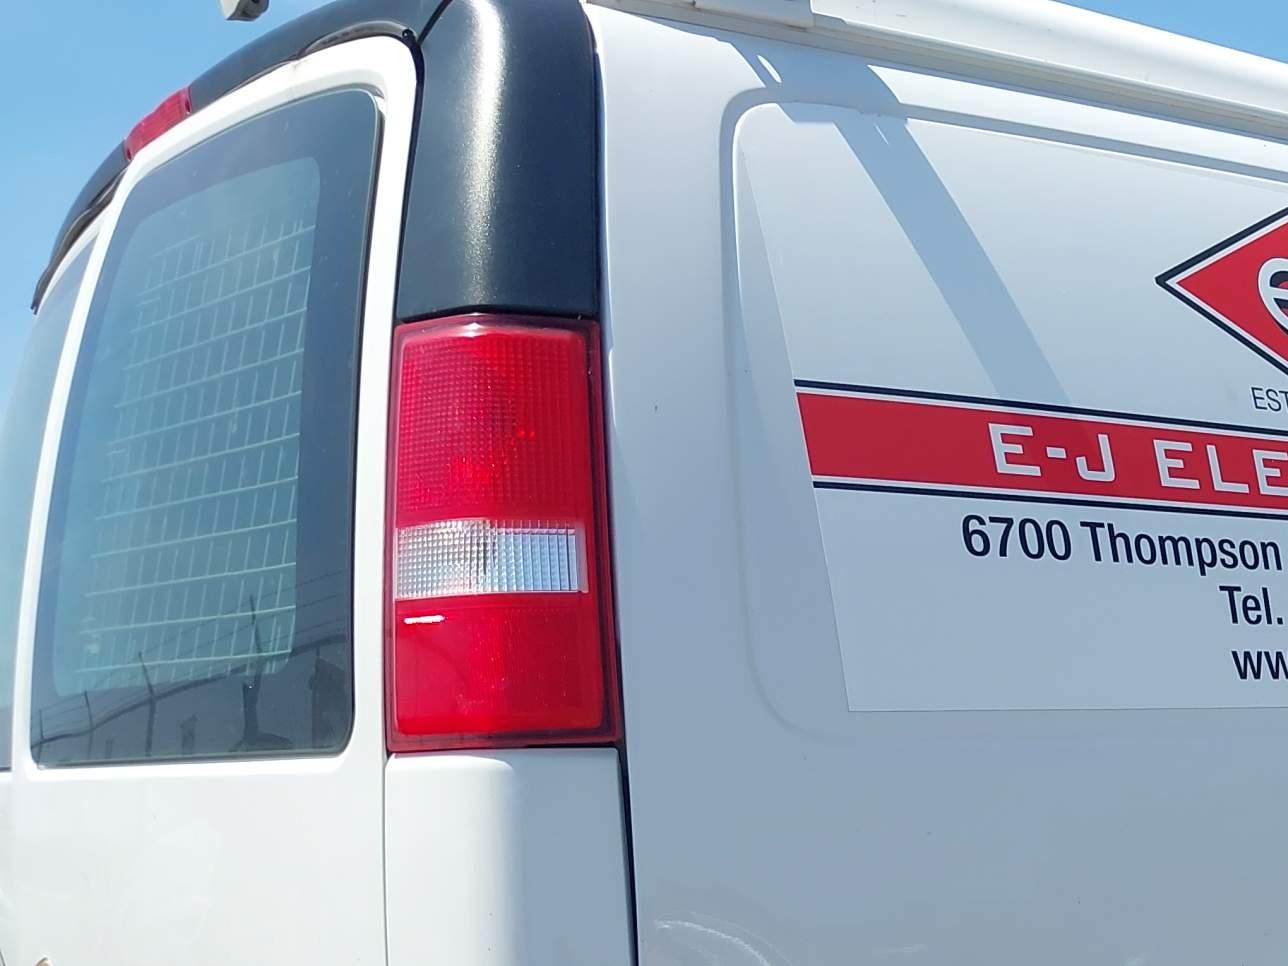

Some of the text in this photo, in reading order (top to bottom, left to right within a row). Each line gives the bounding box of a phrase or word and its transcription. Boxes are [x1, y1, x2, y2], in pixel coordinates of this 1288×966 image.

[988, 422, 1118, 482] E-J
[962, 514, 1073, 562] 6700
[1080, 521, 1283, 576] Thompson
[1219, 585, 1284, 625] Tel.
